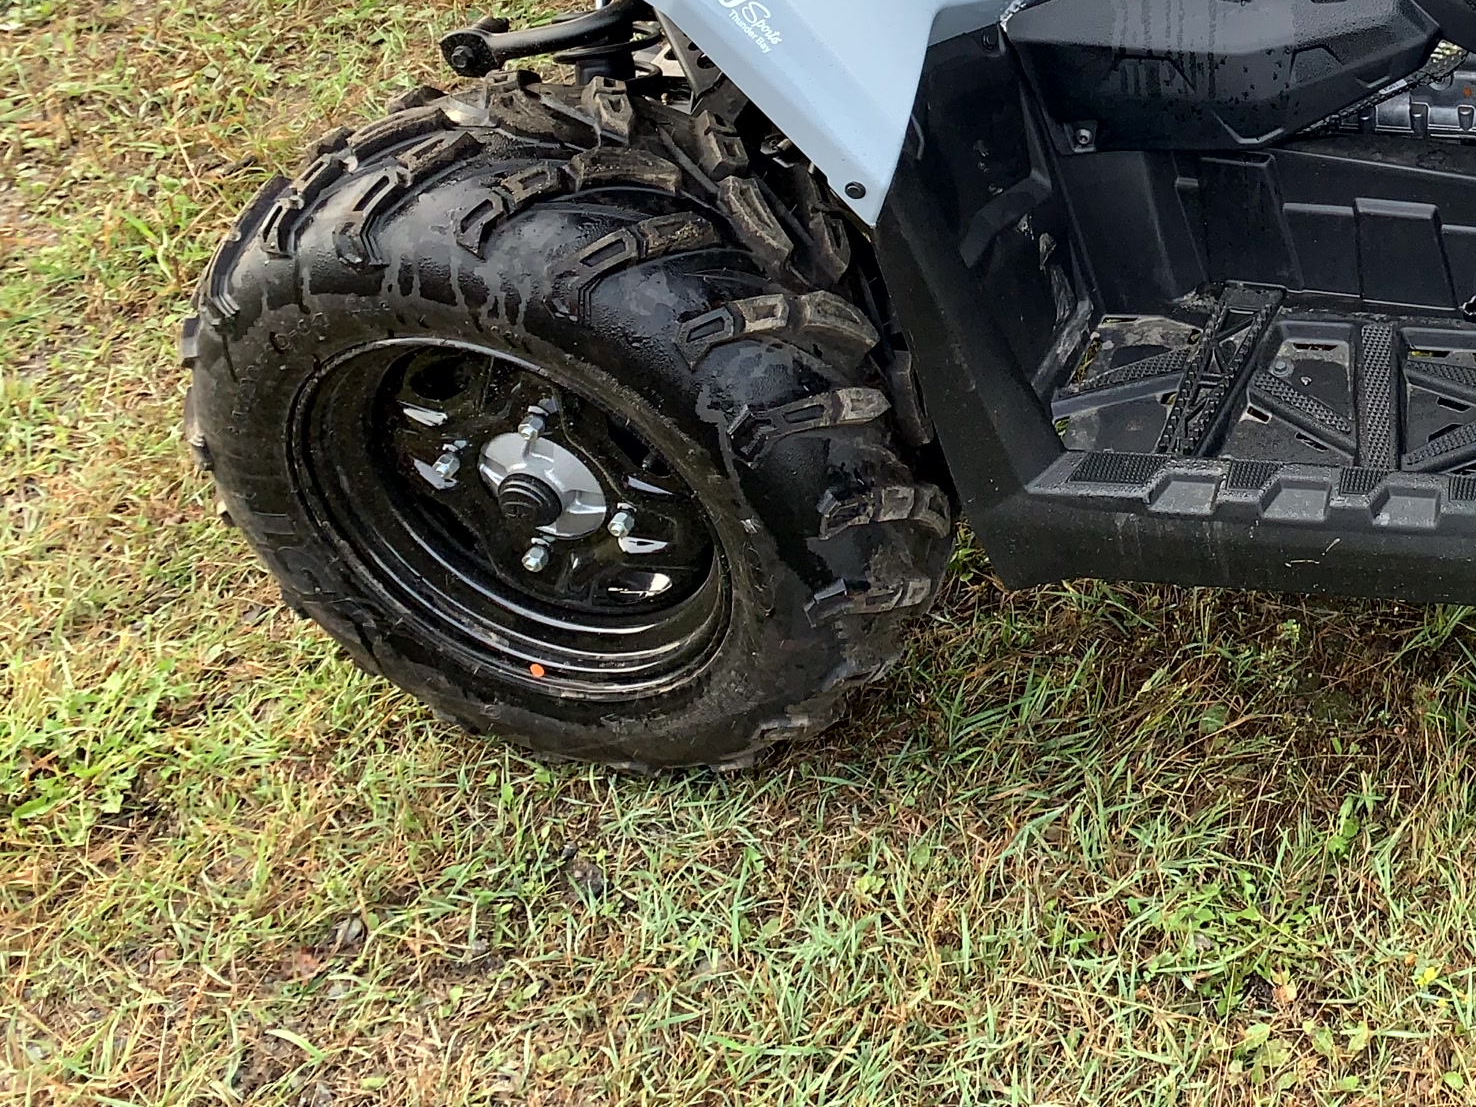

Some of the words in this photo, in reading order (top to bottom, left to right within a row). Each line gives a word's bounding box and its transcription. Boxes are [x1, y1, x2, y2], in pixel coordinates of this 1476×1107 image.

[728, 8, 759, 40] Thunder
[755, 37, 772, 54] Bay
[741, 1, 782, 45] Sports
